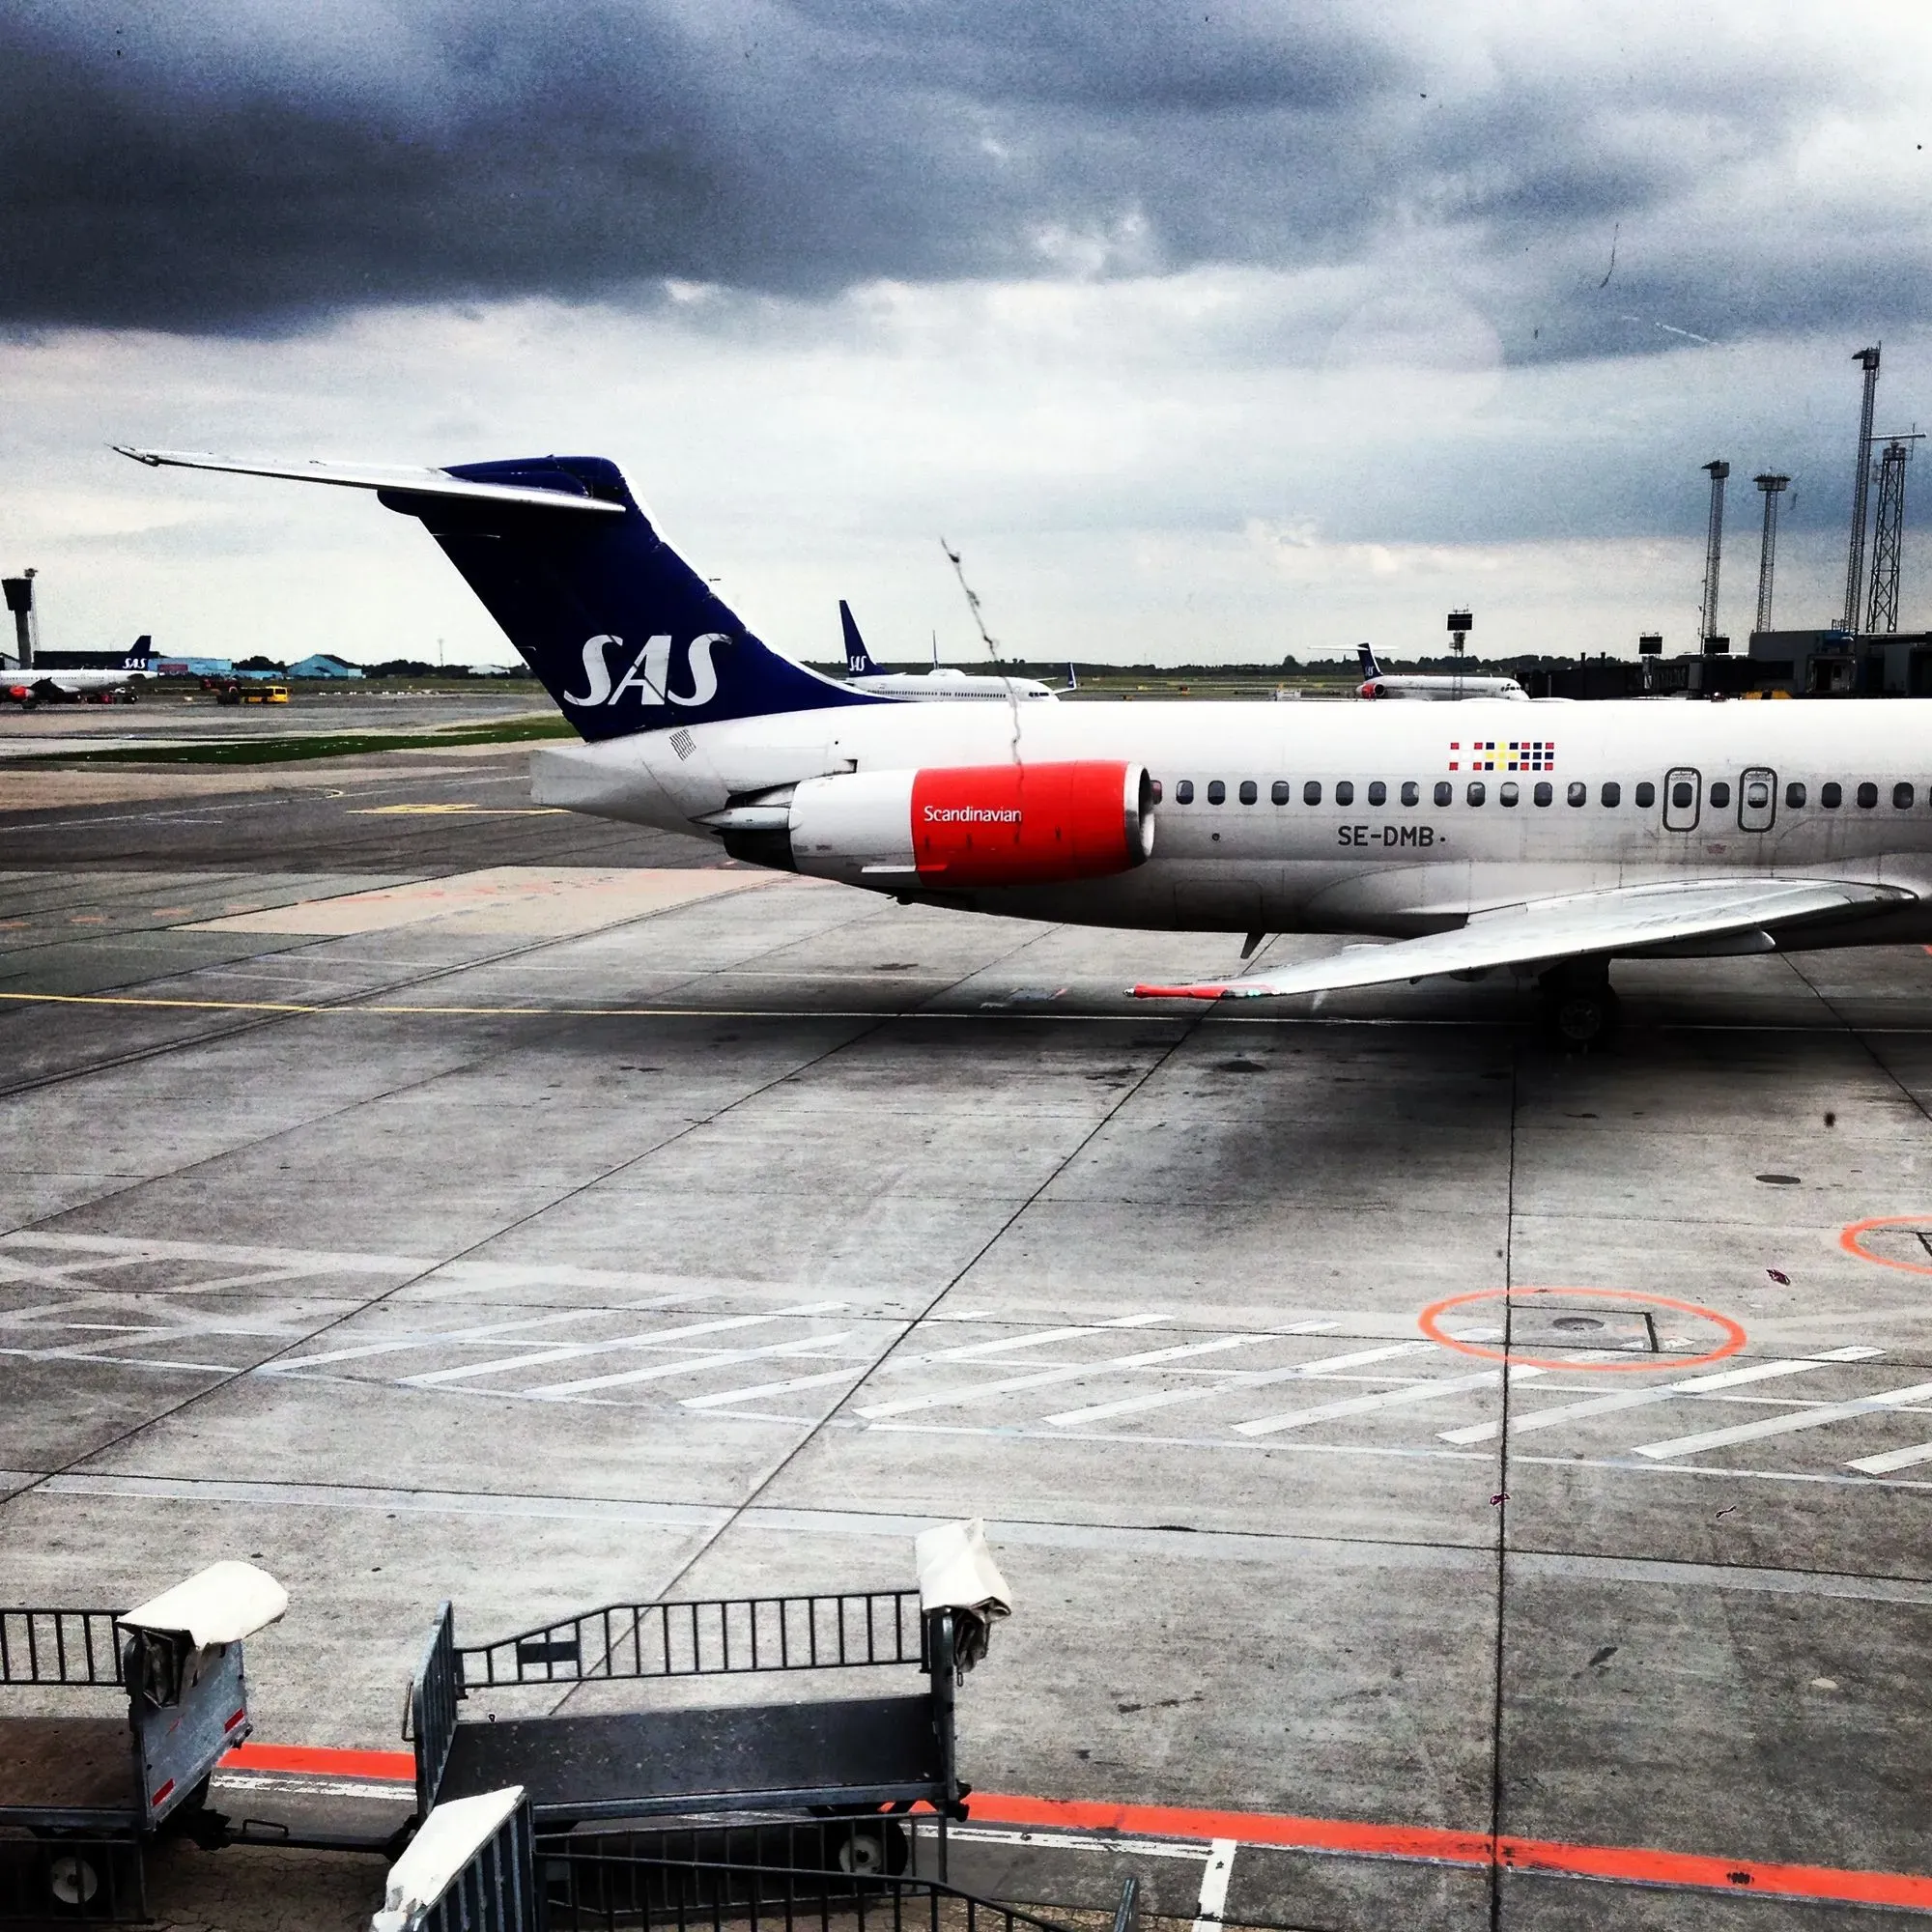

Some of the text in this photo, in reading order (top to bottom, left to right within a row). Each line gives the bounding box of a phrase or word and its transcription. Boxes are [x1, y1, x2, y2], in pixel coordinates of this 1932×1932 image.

[122, 658, 147, 669] SAS
[562, 633, 733, 707] SAS
[848, 655, 867, 672] SAS
[923, 805, 1022, 822] Scandinavian
[1337, 825, 1435, 847] SE-DMB
